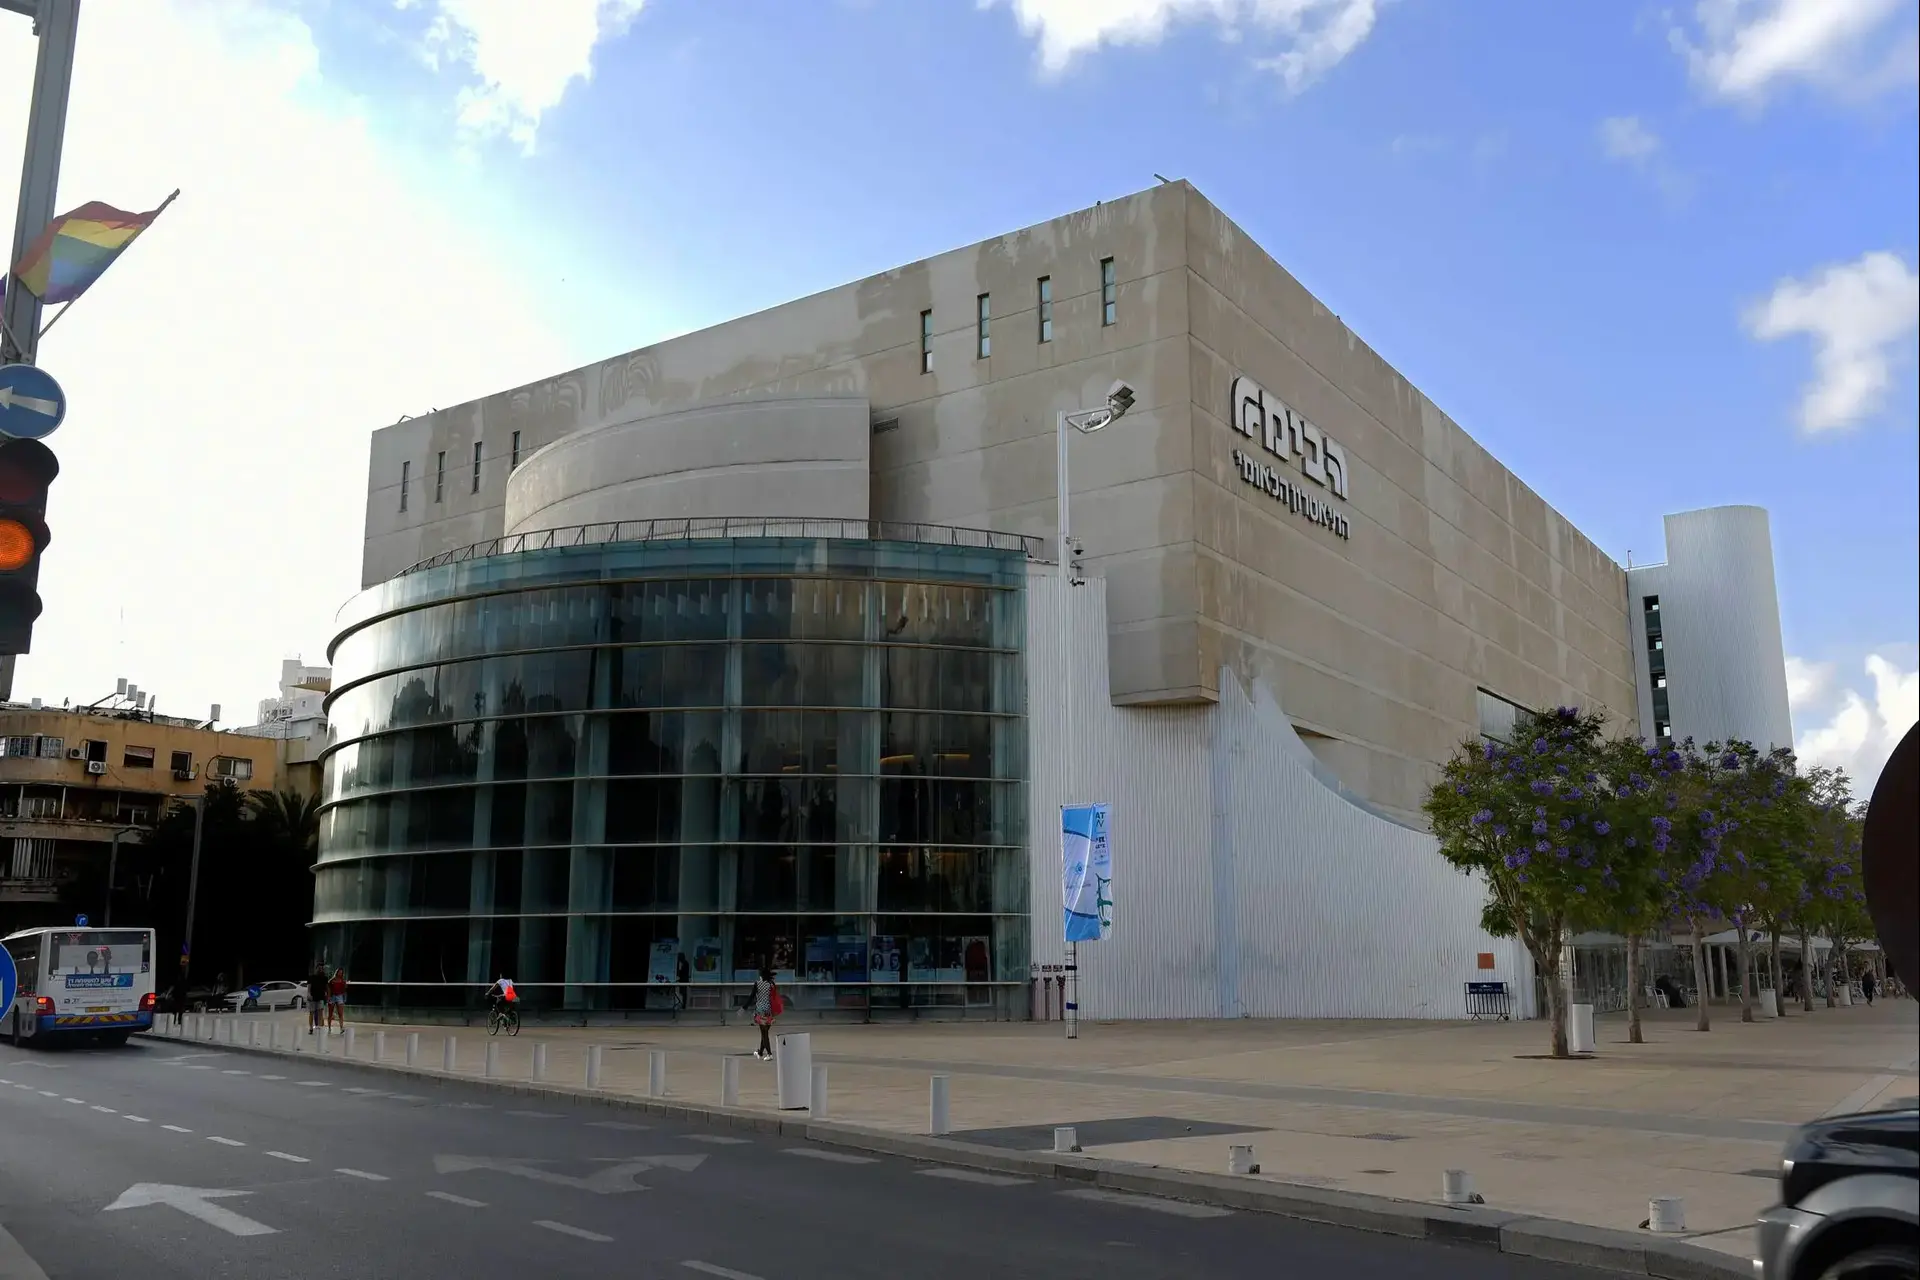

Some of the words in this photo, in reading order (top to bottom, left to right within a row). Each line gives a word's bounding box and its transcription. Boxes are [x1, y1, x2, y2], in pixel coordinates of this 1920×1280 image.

[1231, 376, 1348, 500] הבימה
[1233, 449, 1289, 504] הלאומי
[1290, 483, 1350, 540] התיאטרון
